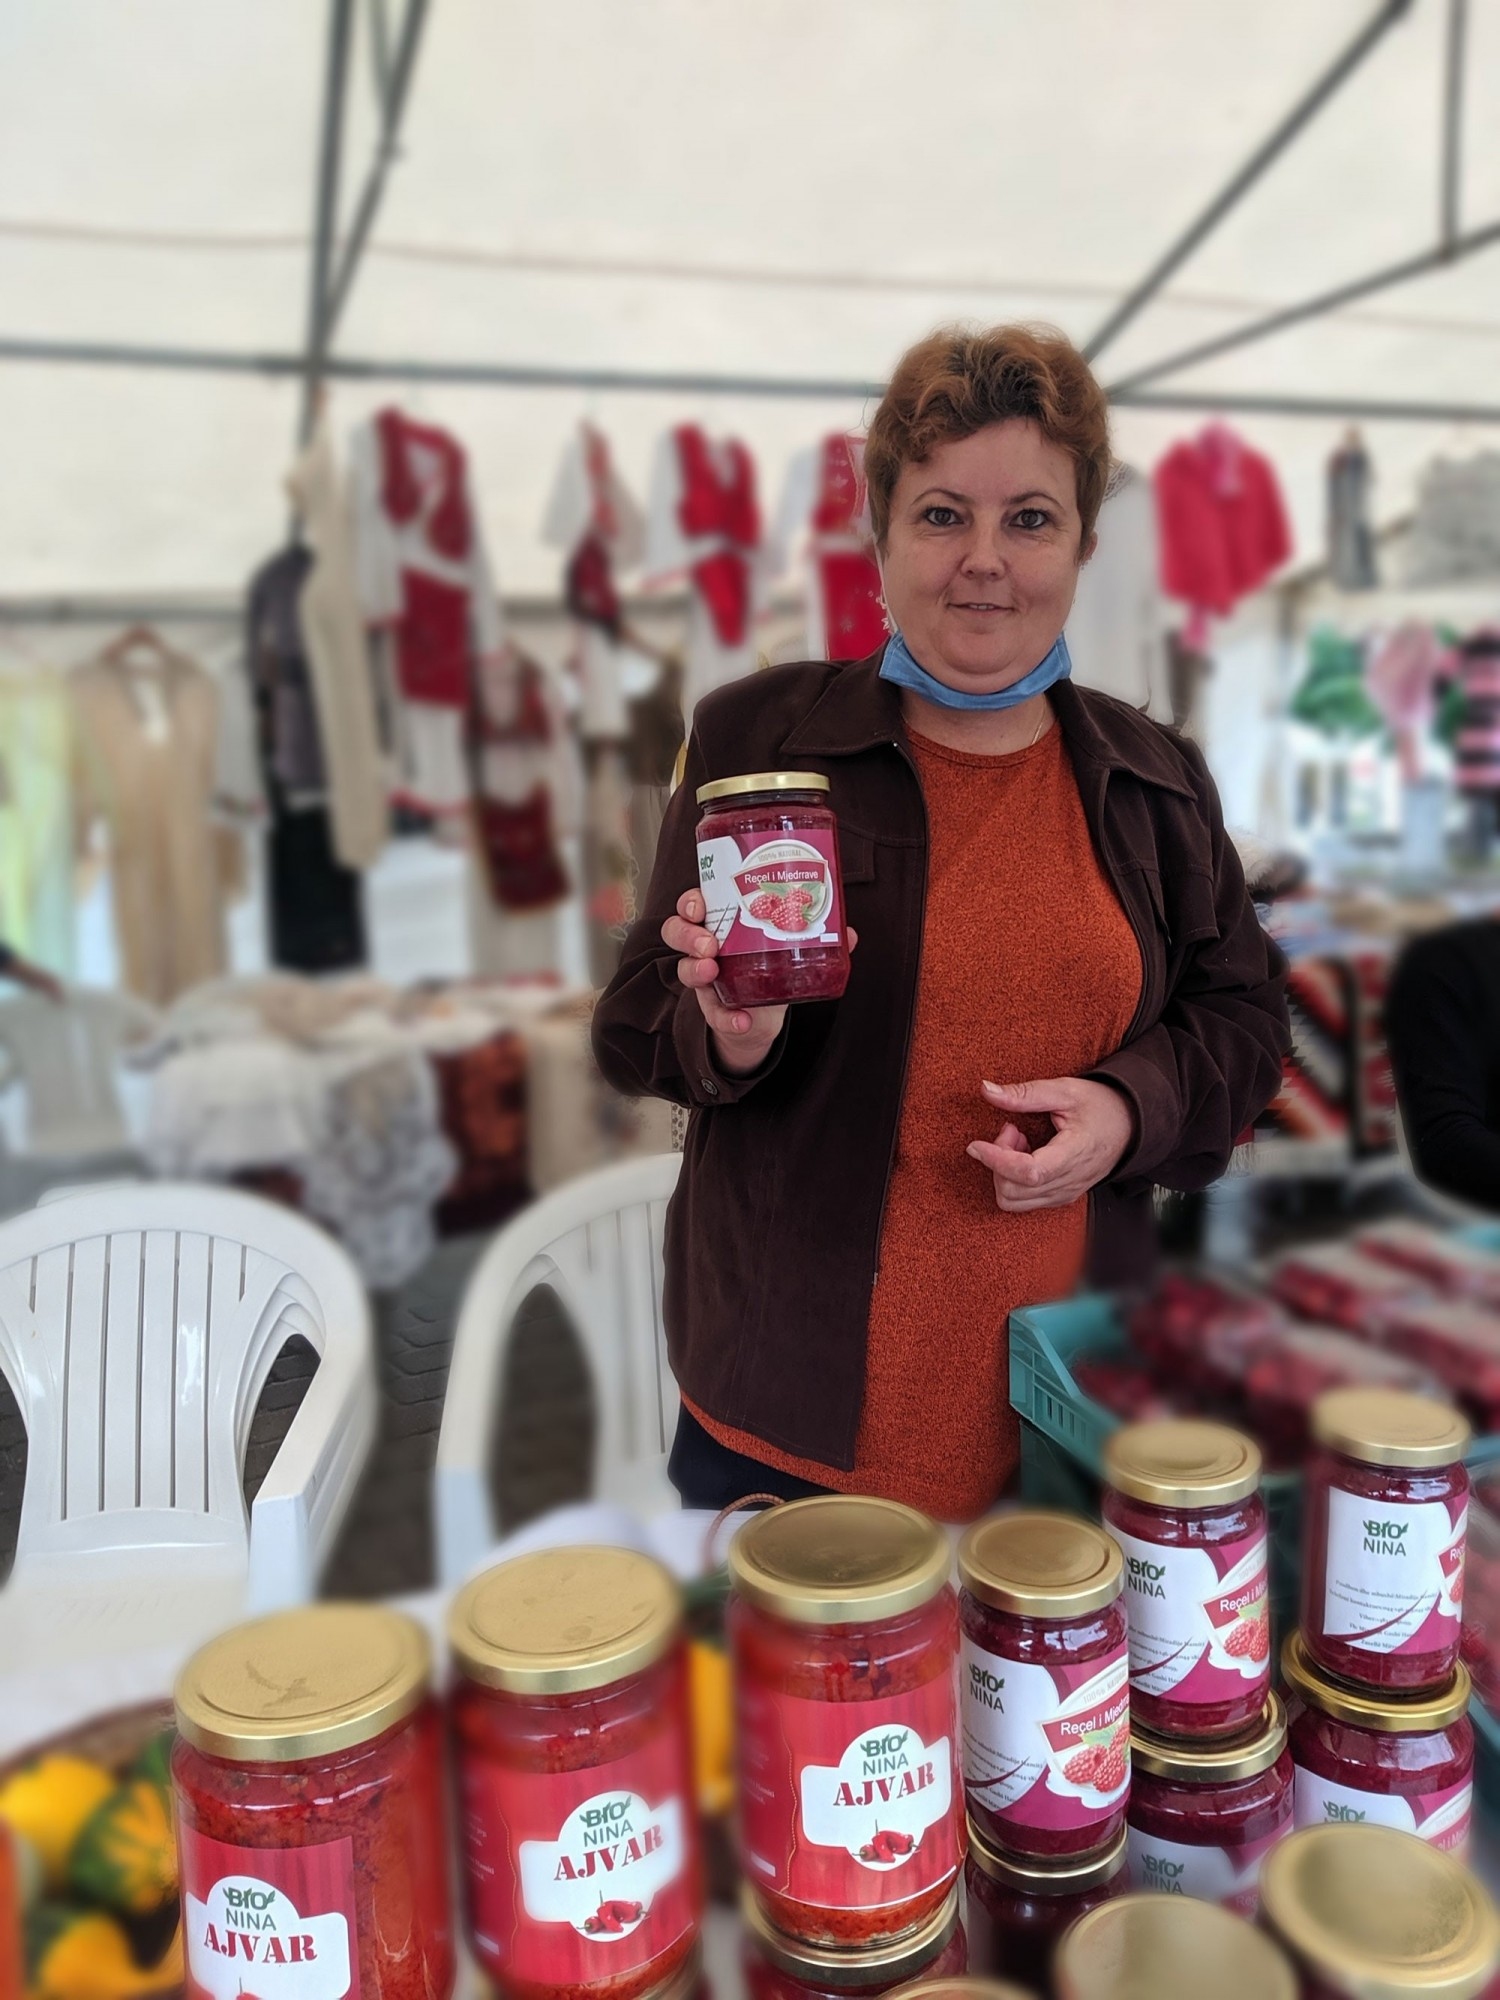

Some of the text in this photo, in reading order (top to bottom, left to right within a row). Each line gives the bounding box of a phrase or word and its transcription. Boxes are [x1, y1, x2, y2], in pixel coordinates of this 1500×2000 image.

[744, 870, 819, 884] Reçel i Mjedrrave
[1363, 1520, 1408, 1539] BIO
[1363, 1537, 1406, 1557] NINA
[1127, 1556, 1166, 1581] BIO
[1128, 1575, 1166, 1600] NINA
[1220, 1591, 1250, 1613] Reçel
[1251, 1589, 1254, 1601] i
[969, 1663, 1005, 1693] BIO
[970, 1681, 1005, 1714] NINA
[1061, 1715, 1096, 1736] Reçel
[1099, 1713, 1102, 1727] i
[860, 1730, 908, 1758] BIO
[863, 1753, 909, 1776] NINA
[833, 1761, 936, 1807] AJVAR
[580, 1796, 632, 1828] BIO
[583, 1821, 633, 1848] NINA
[554, 1824, 664, 1882] AJVAR
[1141, 1854, 1184, 1877] BIO
[1142, 1870, 1183, 1895] NINA
[222, 1887, 275, 1911] BIO
[225, 1908, 277, 1931] NINA
[203, 1923, 318, 1964] AJVAR
